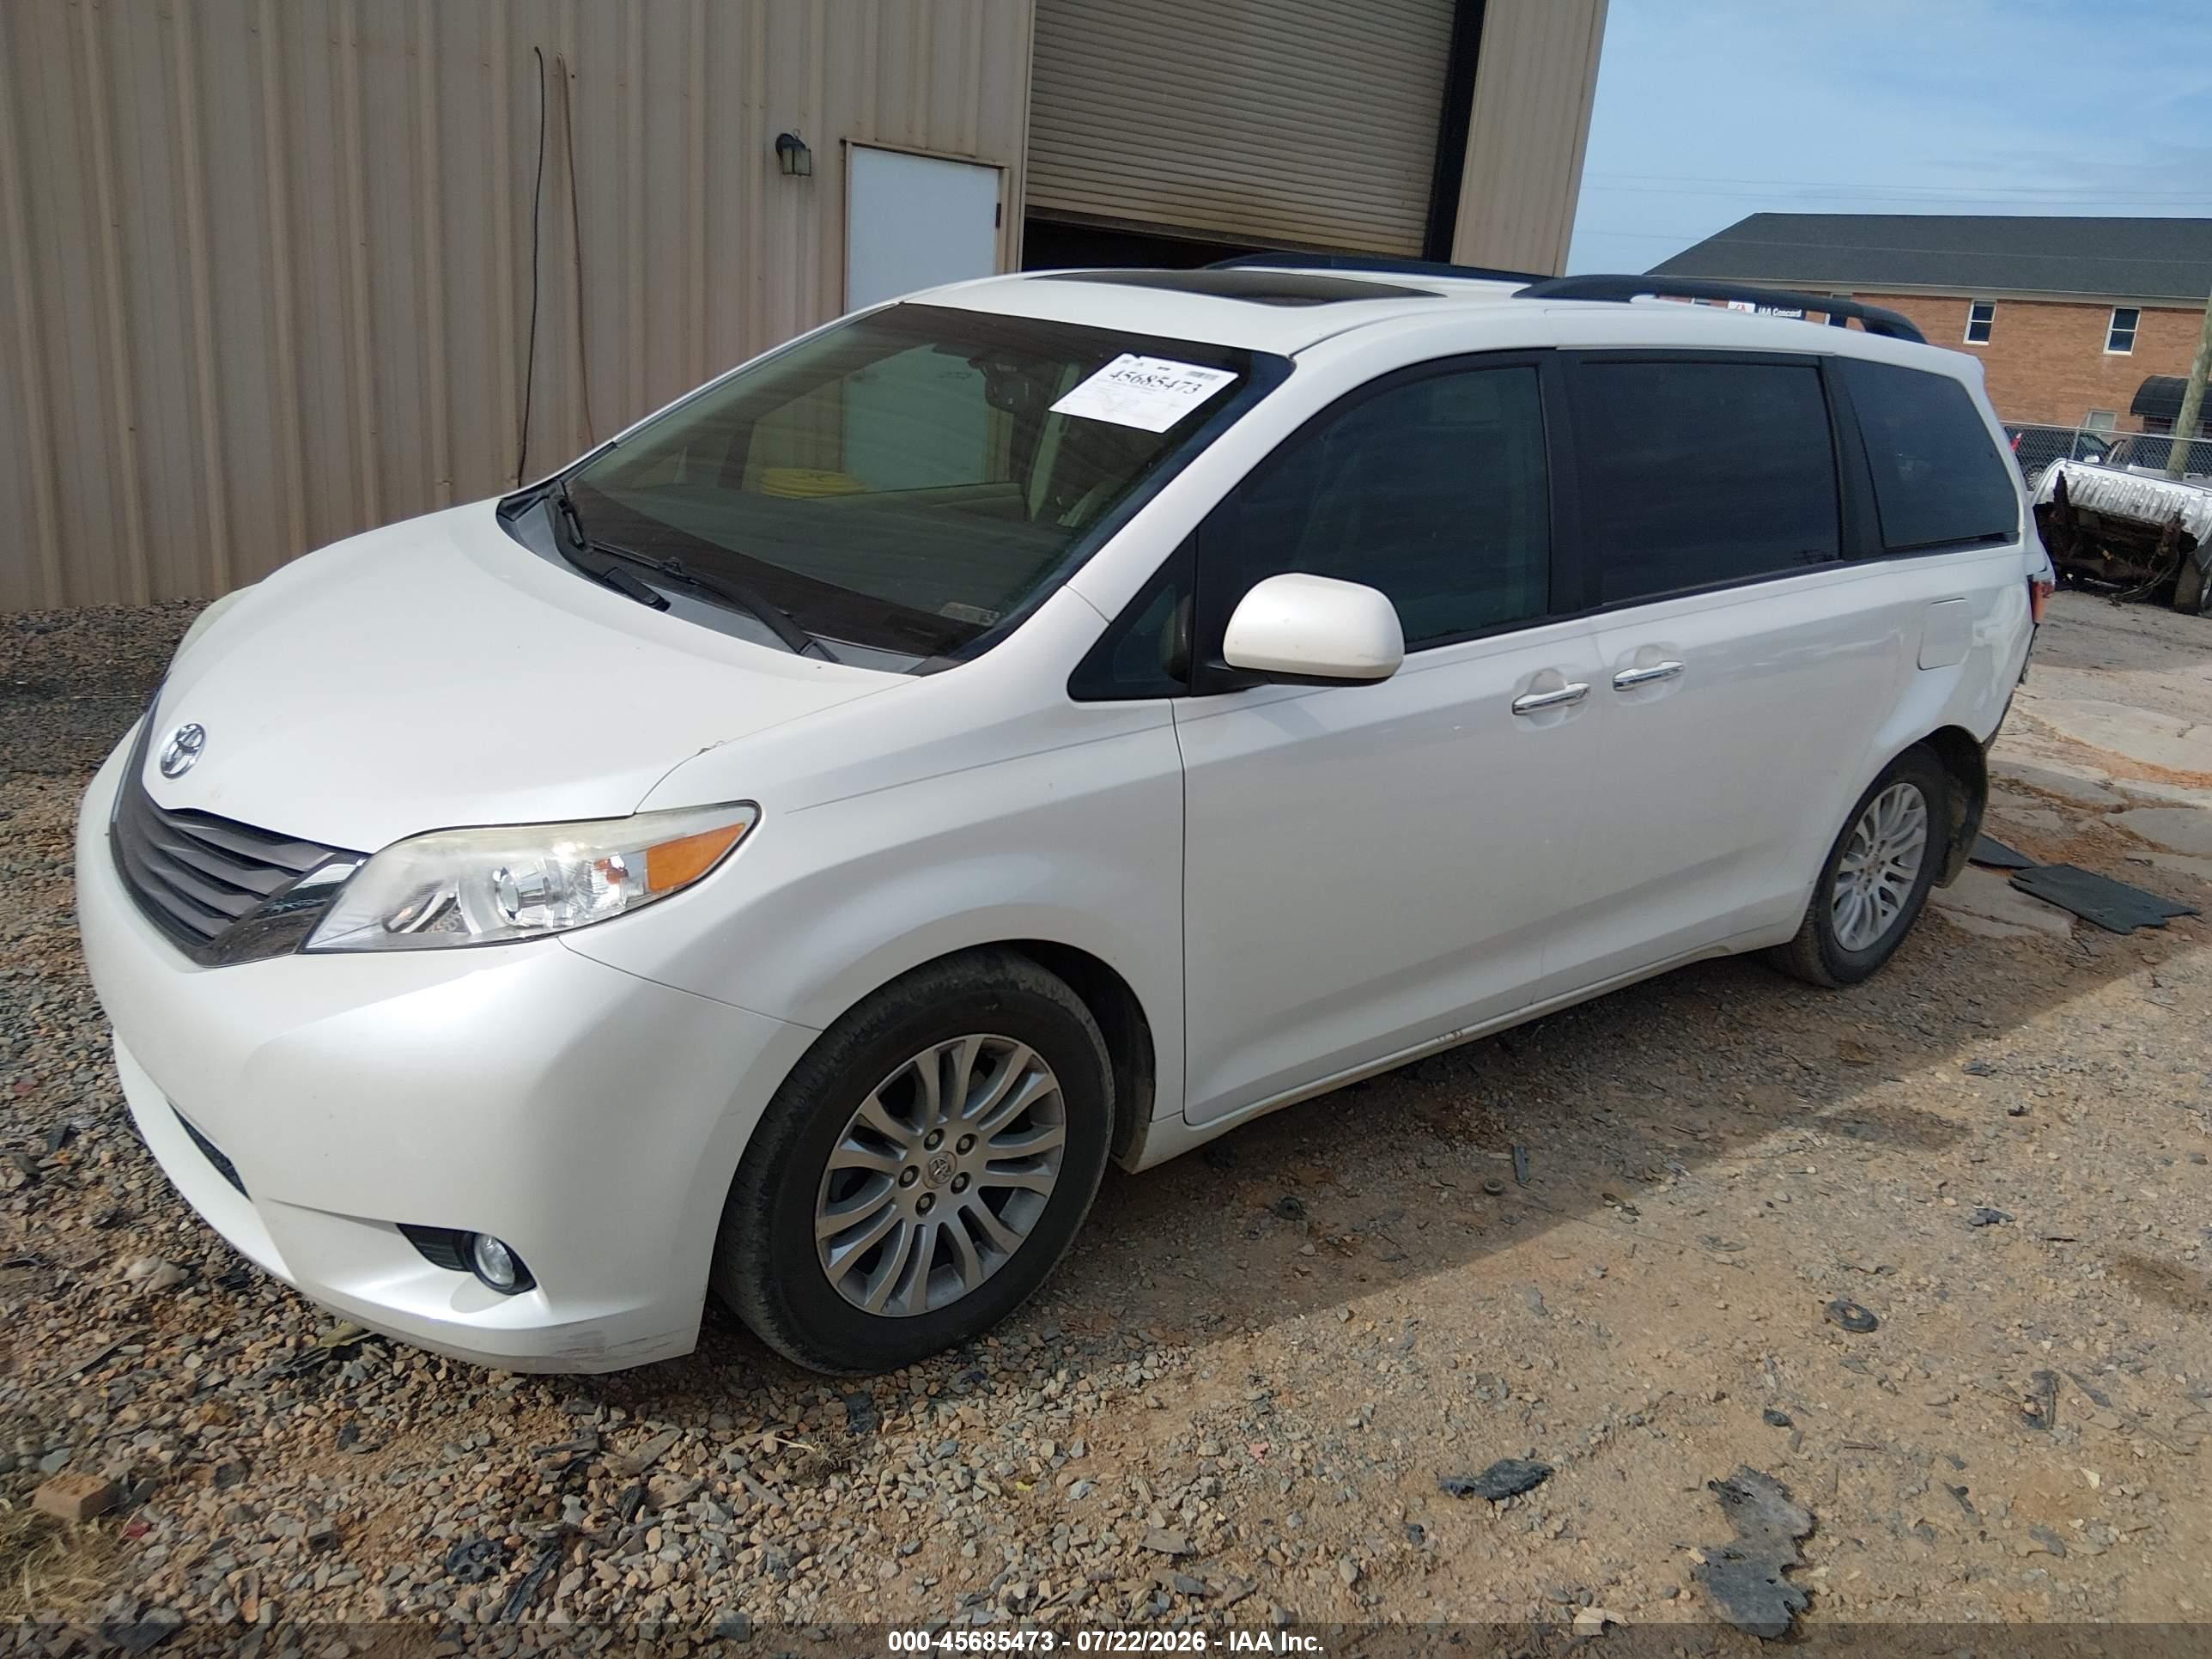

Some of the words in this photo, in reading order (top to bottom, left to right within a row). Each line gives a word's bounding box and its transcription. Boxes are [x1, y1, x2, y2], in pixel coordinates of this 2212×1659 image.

[1758, 307, 1771, 317] IAA
[1772, 307, 1802, 318] Concord
[1109, 370, 1202, 394] 45685473
